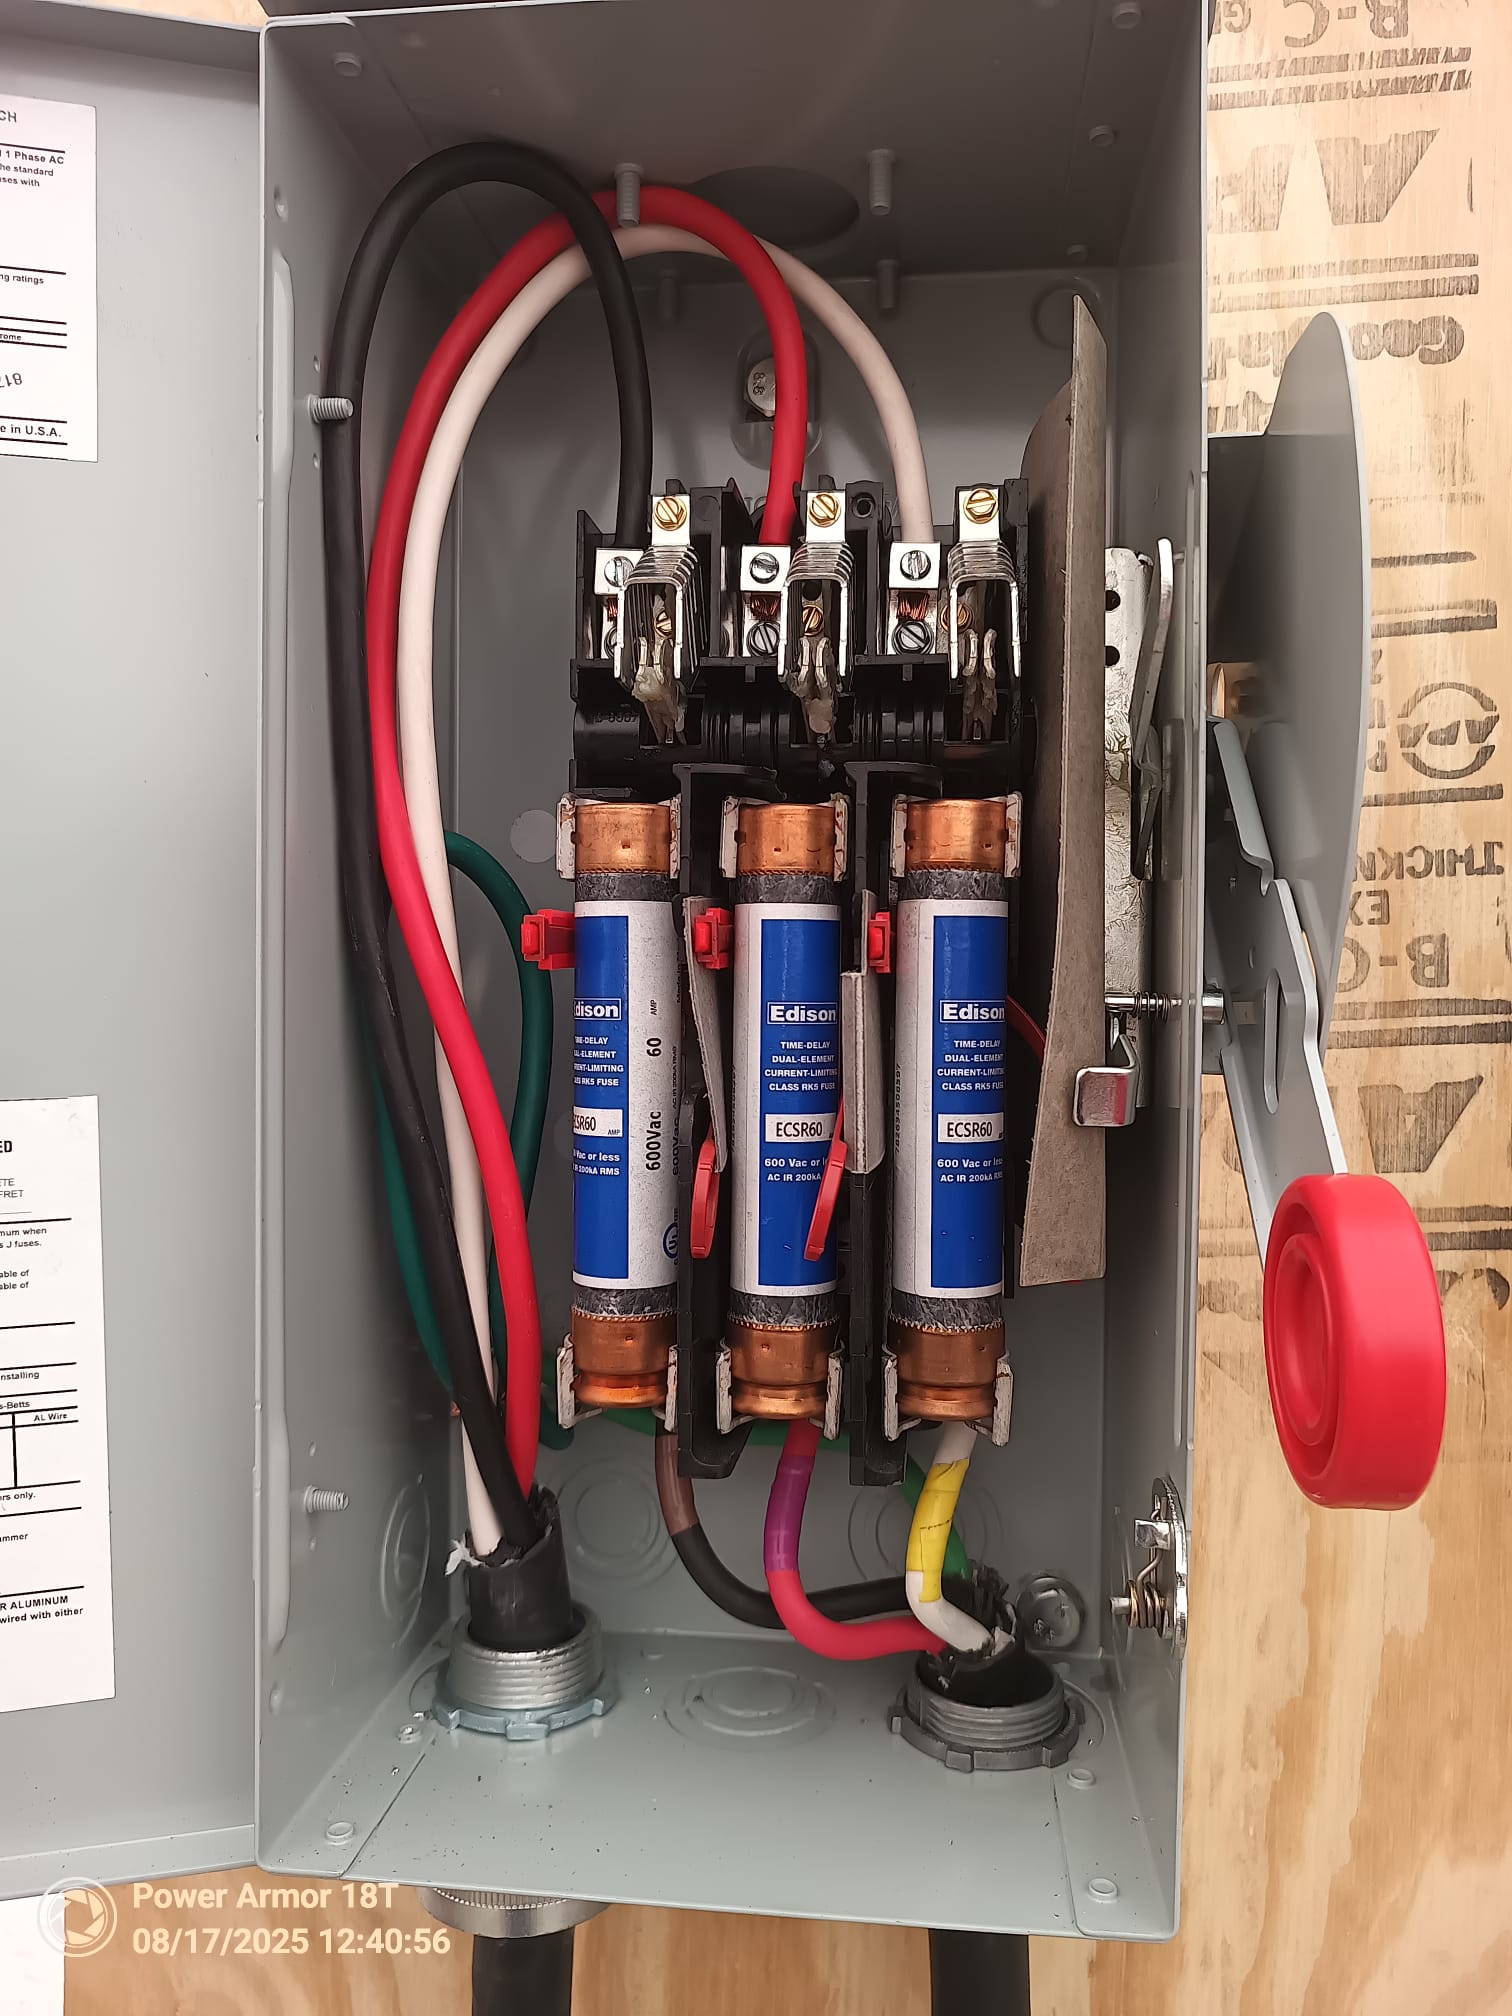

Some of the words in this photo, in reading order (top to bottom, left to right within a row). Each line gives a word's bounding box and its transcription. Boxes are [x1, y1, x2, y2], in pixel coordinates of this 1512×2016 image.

[14, 150, 46, 163] Phase
[48, 155, 65, 165] AC
[13, 164, 54, 177] standard
[20, 178, 40, 187] with
[12, 274, 45, 286] ratings
[10, 423, 21, 434] in
[25, 425, 62, 438] U.S.A.
[650, 999, 658, 1016] AMP
[942, 1002, 1005, 1021] Edison
[769, 1004, 837, 1022] Edison
[646, 1036, 662, 1057] 60
[780, 1040, 831, 1050] TIME-DELAY
[953, 1039, 1001, 1049] TIME-DELAY
[771, 1054, 836, 1064] DUAL-ELEMENT
[597, 1077, 620, 1088] FUSE
[768, 1082, 800, 1092] CLASS
[801, 1082, 819, 1091] RK5
[941, 1081, 973, 1091] CLASS
[974, 1081, 991, 1091] RK5
[607, 1128, 621, 1137] AMP
[775, 1121, 823, 1138] ECSR60
[946, 1121, 993, 1138] ECSR60
[645, 1110, 662, 1172] 600Vac
[588, 1153, 598, 1162] or
[598, 1151, 621, 1163] less
[764, 1158, 787, 1168] 600
[788, 1157, 808, 1168] Vac
[810, 1158, 821, 1167] or
[937, 1158, 959, 1169] 600
[961, 1158, 981, 1168] Vac
[982, 1158, 992, 1168] or
[599, 1167, 620, 1177] RMS
[767, 1173, 781, 1182] AC
[783, 1173, 793, 1182] IR
[795, 1172, 822, 1182] 200kA
[940, 1173, 954, 1183] AC
[956, 1173, 967, 1183] IR
[968, 1173, 993, 1183] 200kA
[22, 1227, 47, 1236] when
[6, 1240, 12, 1249] J
[14, 1239, 42, 1249] fuses.
[20, 1268, 29, 1278] of
[19, 1280, 29, 1289] of
[0, 1371, 40, 1381] nstalling
[0, 1401, 30, 1410] s-Betts
[33, 1414, 46, 1422] AL
[47, 1412, 68, 1421] Wire
[13, 1491, 36, 1501] only.
[10, 1595, 69, 1611] ALUMINUM
[0, 1612, 27, 1625] wired
[30, 1611, 52, 1621] with
[54, 1607, 84, 1618] either
